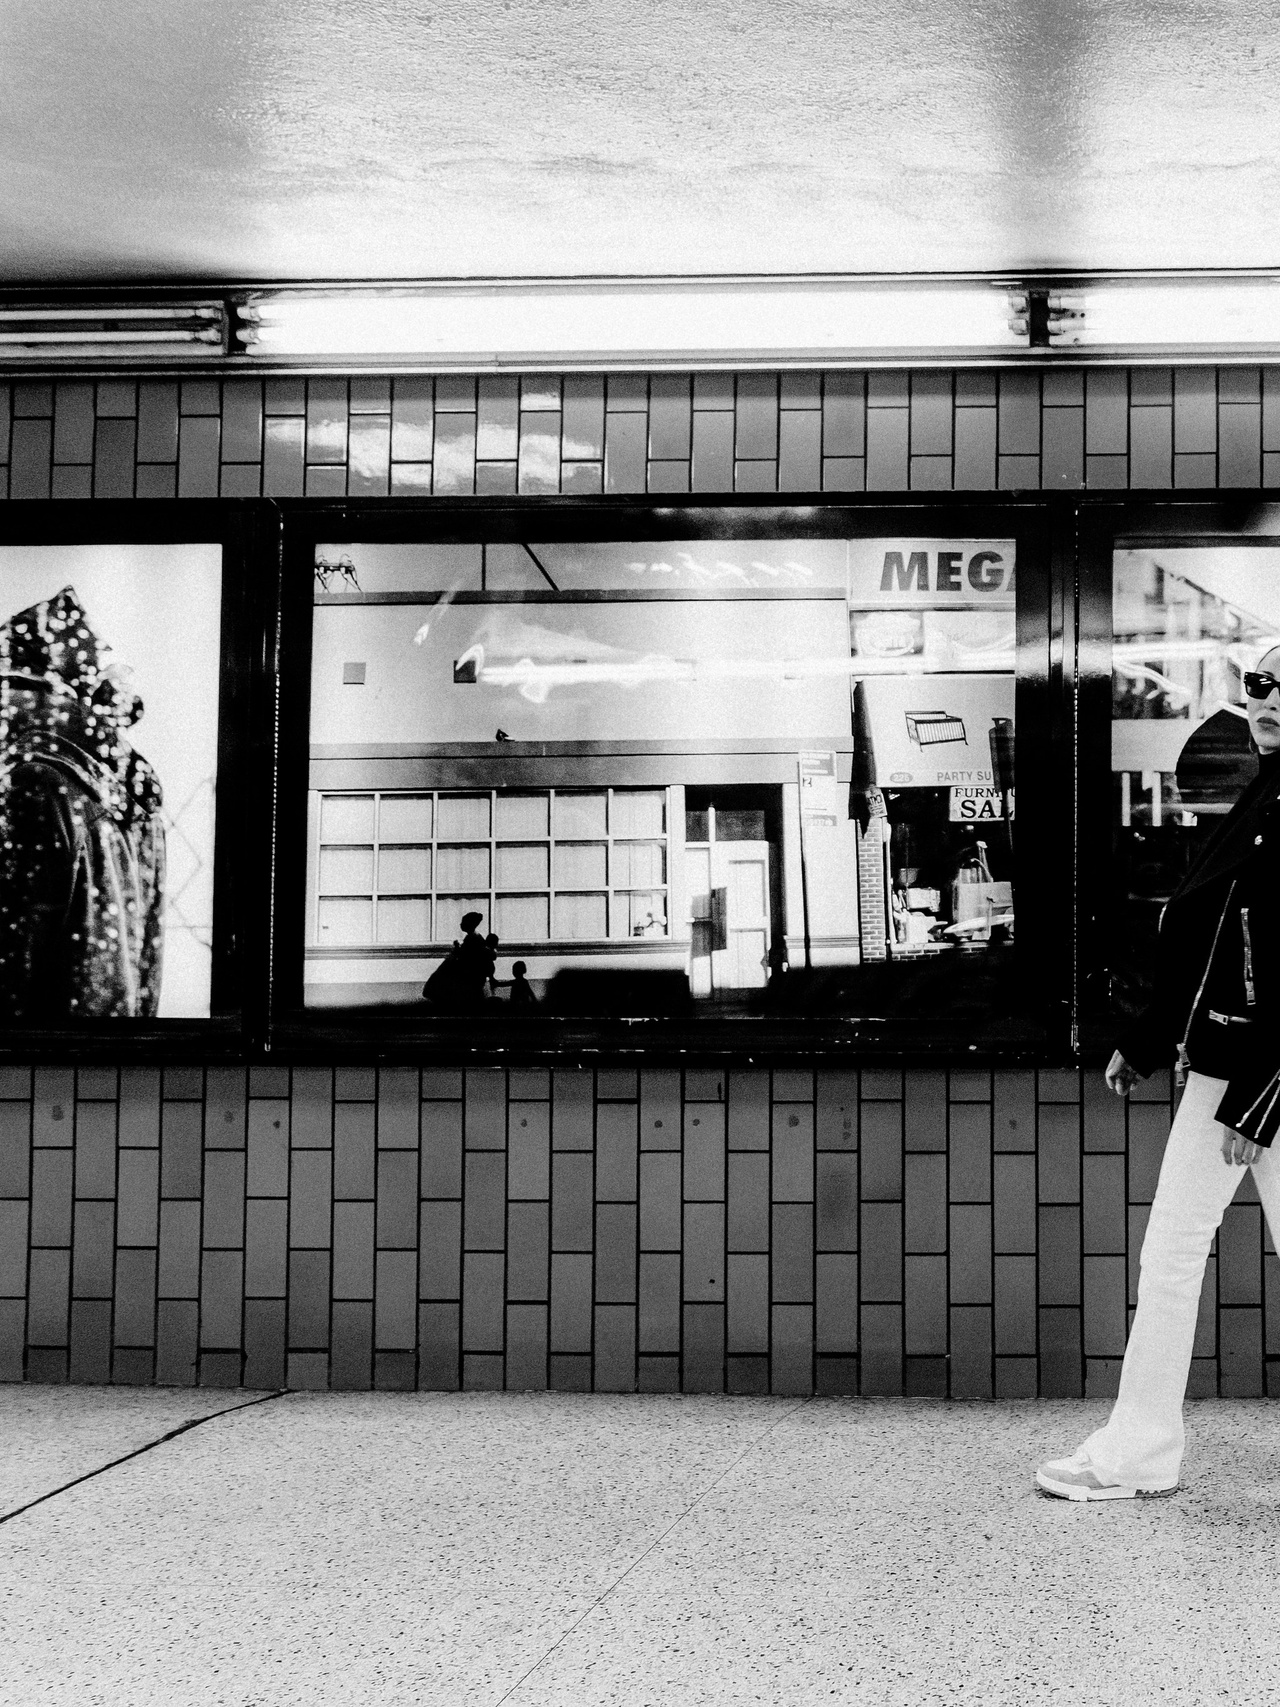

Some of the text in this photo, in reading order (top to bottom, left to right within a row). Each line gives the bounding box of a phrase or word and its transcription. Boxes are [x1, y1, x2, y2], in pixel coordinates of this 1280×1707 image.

[880, 551, 1016, 592] MEG
[937, 770, 992, 781] PARTY SU
